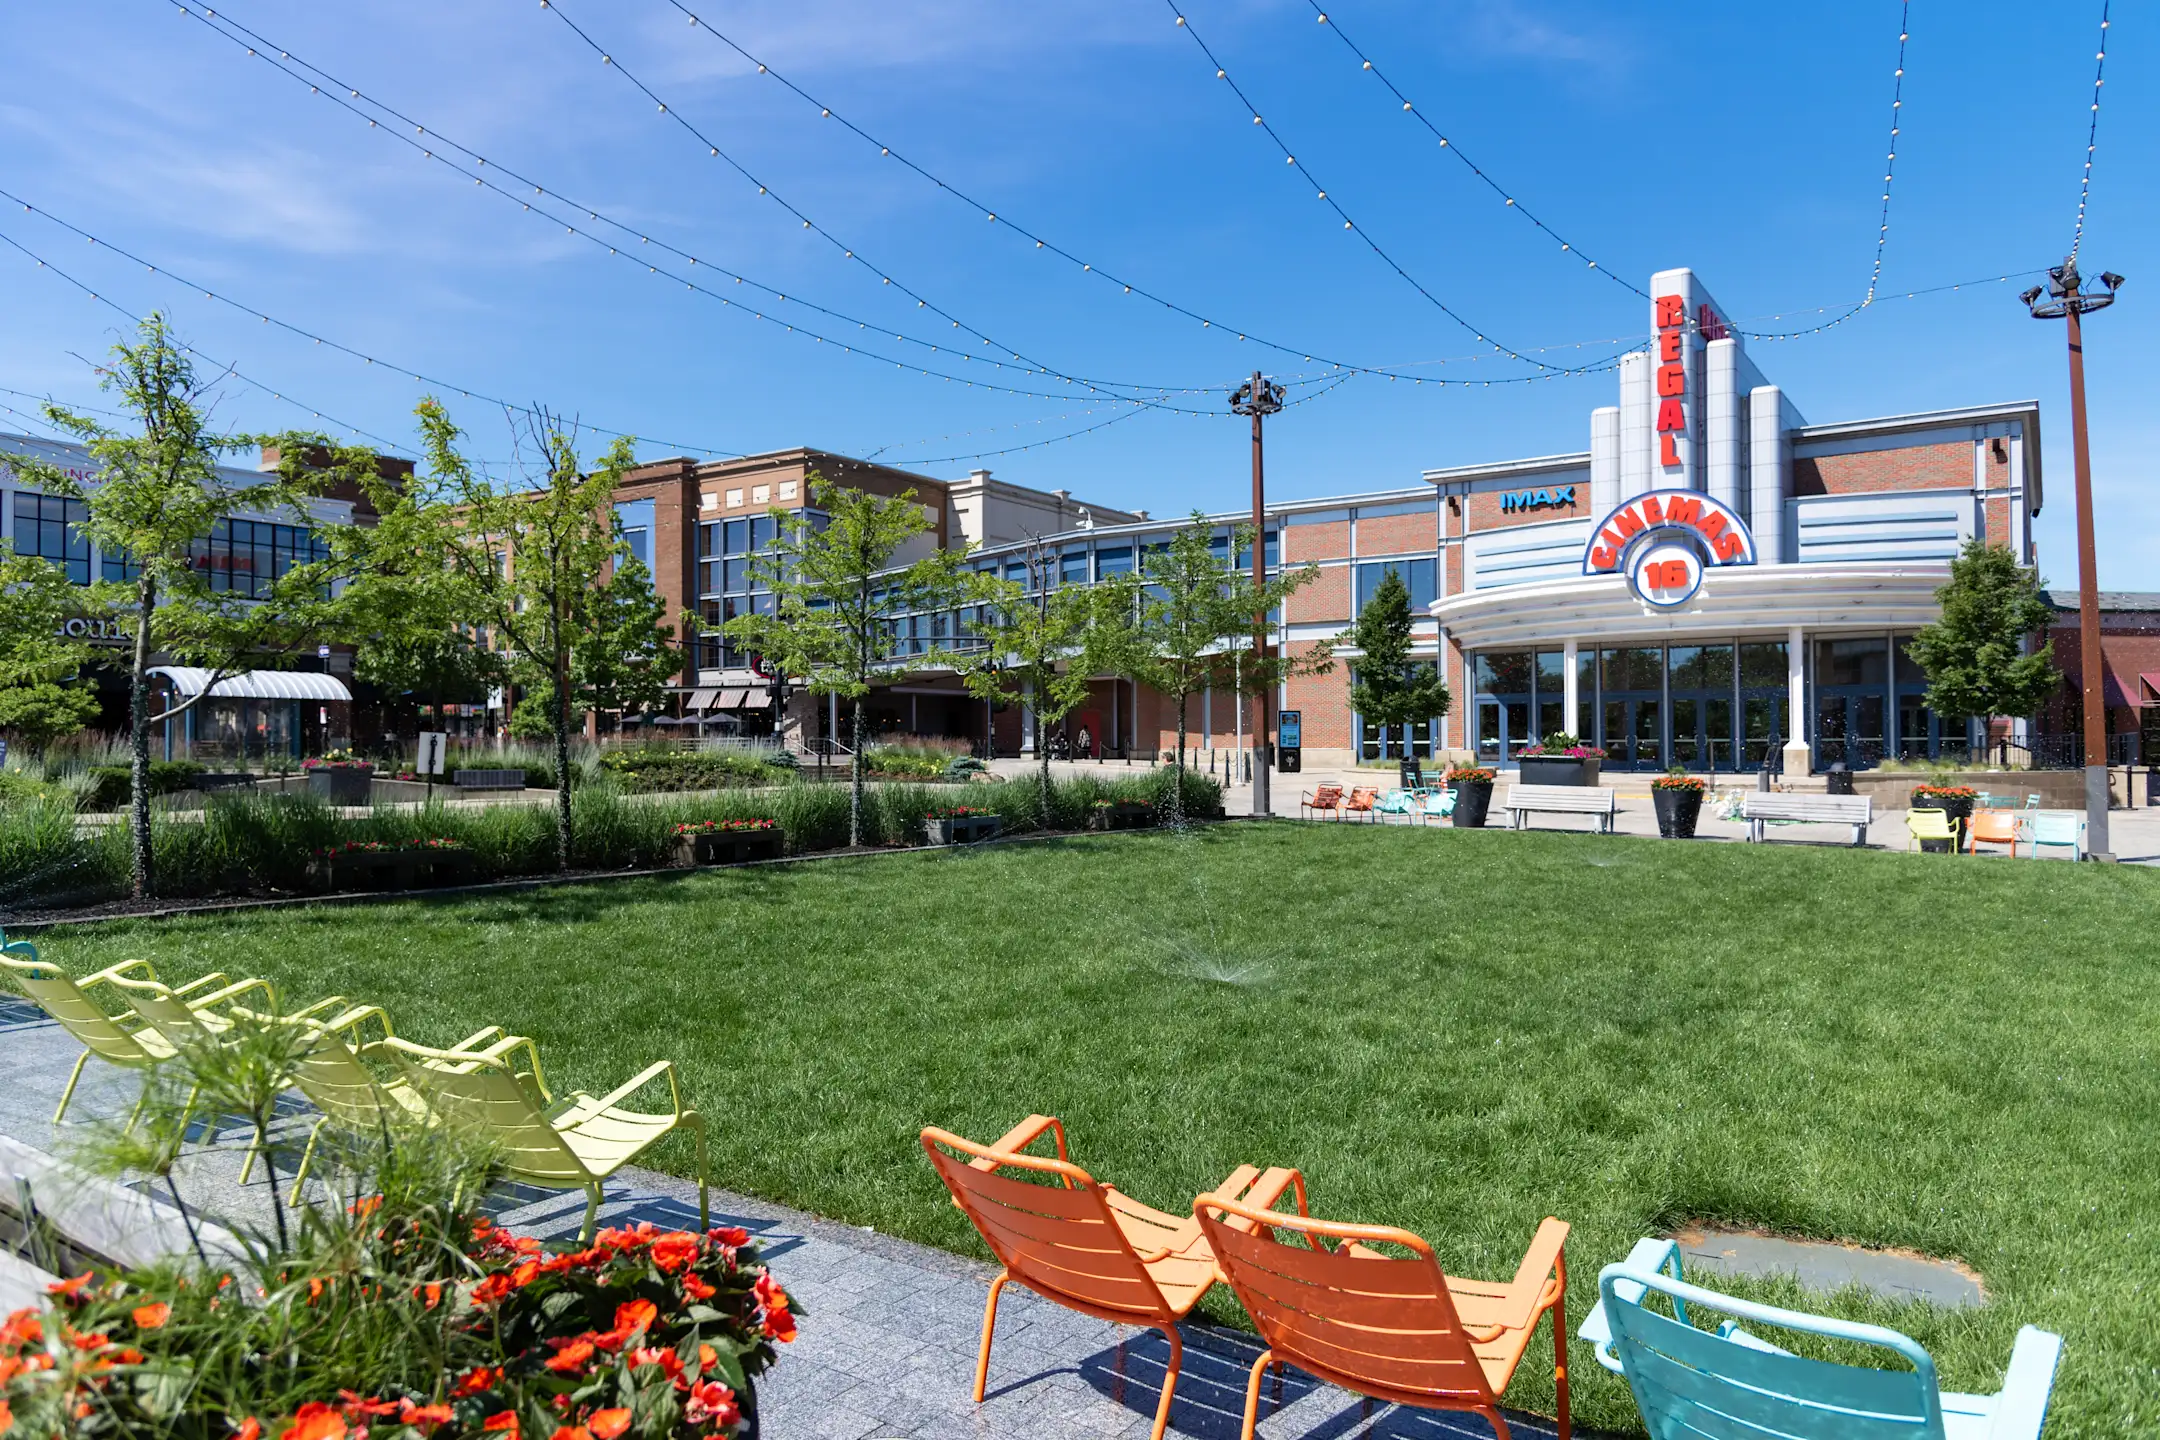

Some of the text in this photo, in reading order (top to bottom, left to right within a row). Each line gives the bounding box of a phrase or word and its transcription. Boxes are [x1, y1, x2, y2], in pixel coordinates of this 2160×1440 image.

[1657, 295, 1684, 466] REGAL
[1500, 486, 1575, 508] IMAX
[1591, 496, 1743, 568] CINEMAS
[1644, 560, 1687, 589] 16
